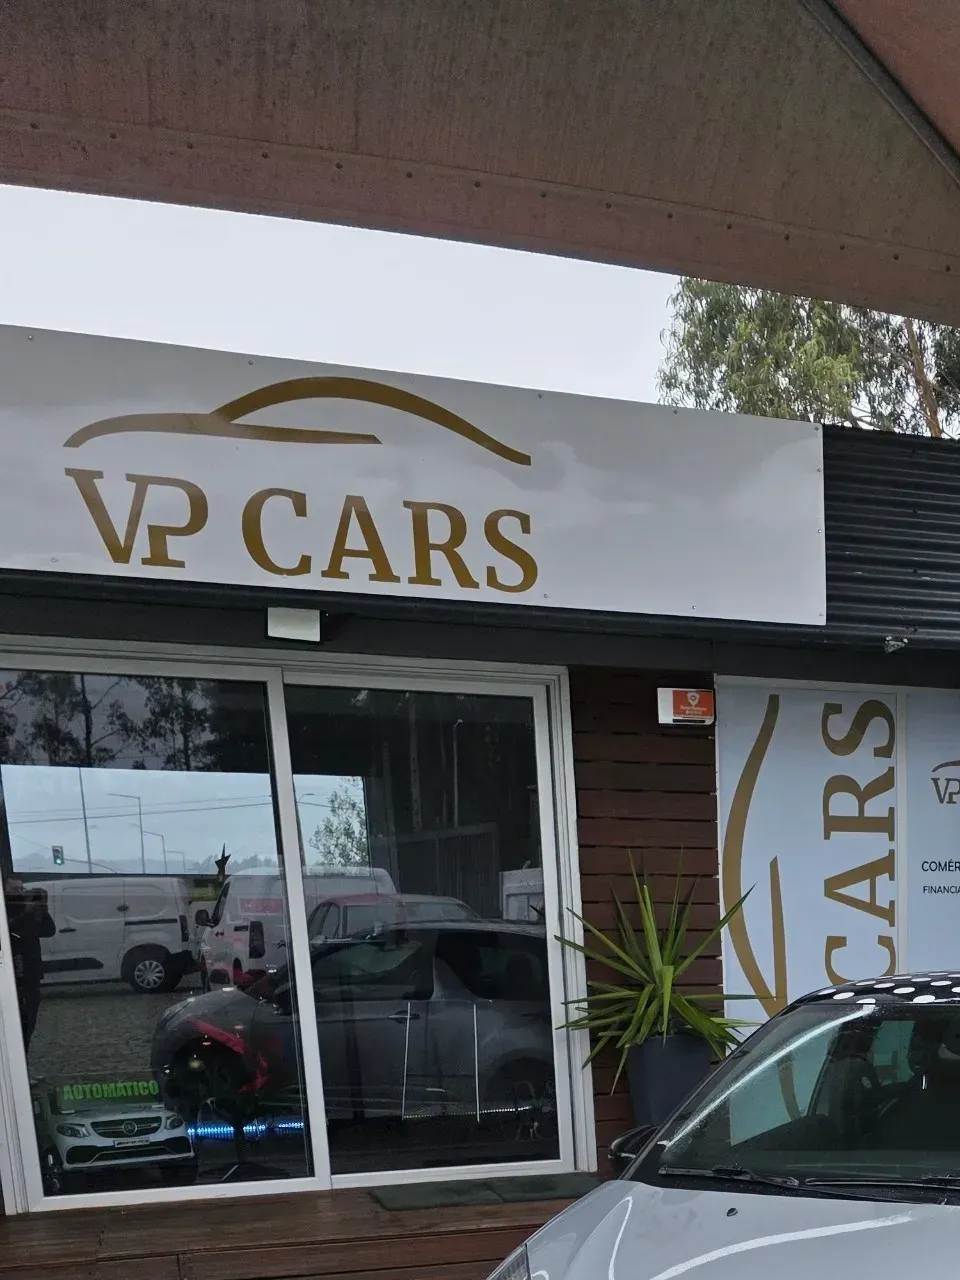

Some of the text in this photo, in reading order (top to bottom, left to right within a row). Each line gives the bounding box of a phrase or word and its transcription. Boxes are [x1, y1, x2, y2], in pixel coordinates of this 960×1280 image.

[64, 467, 540, 594] VP CARS
[821, 699, 897, 985] CARS
